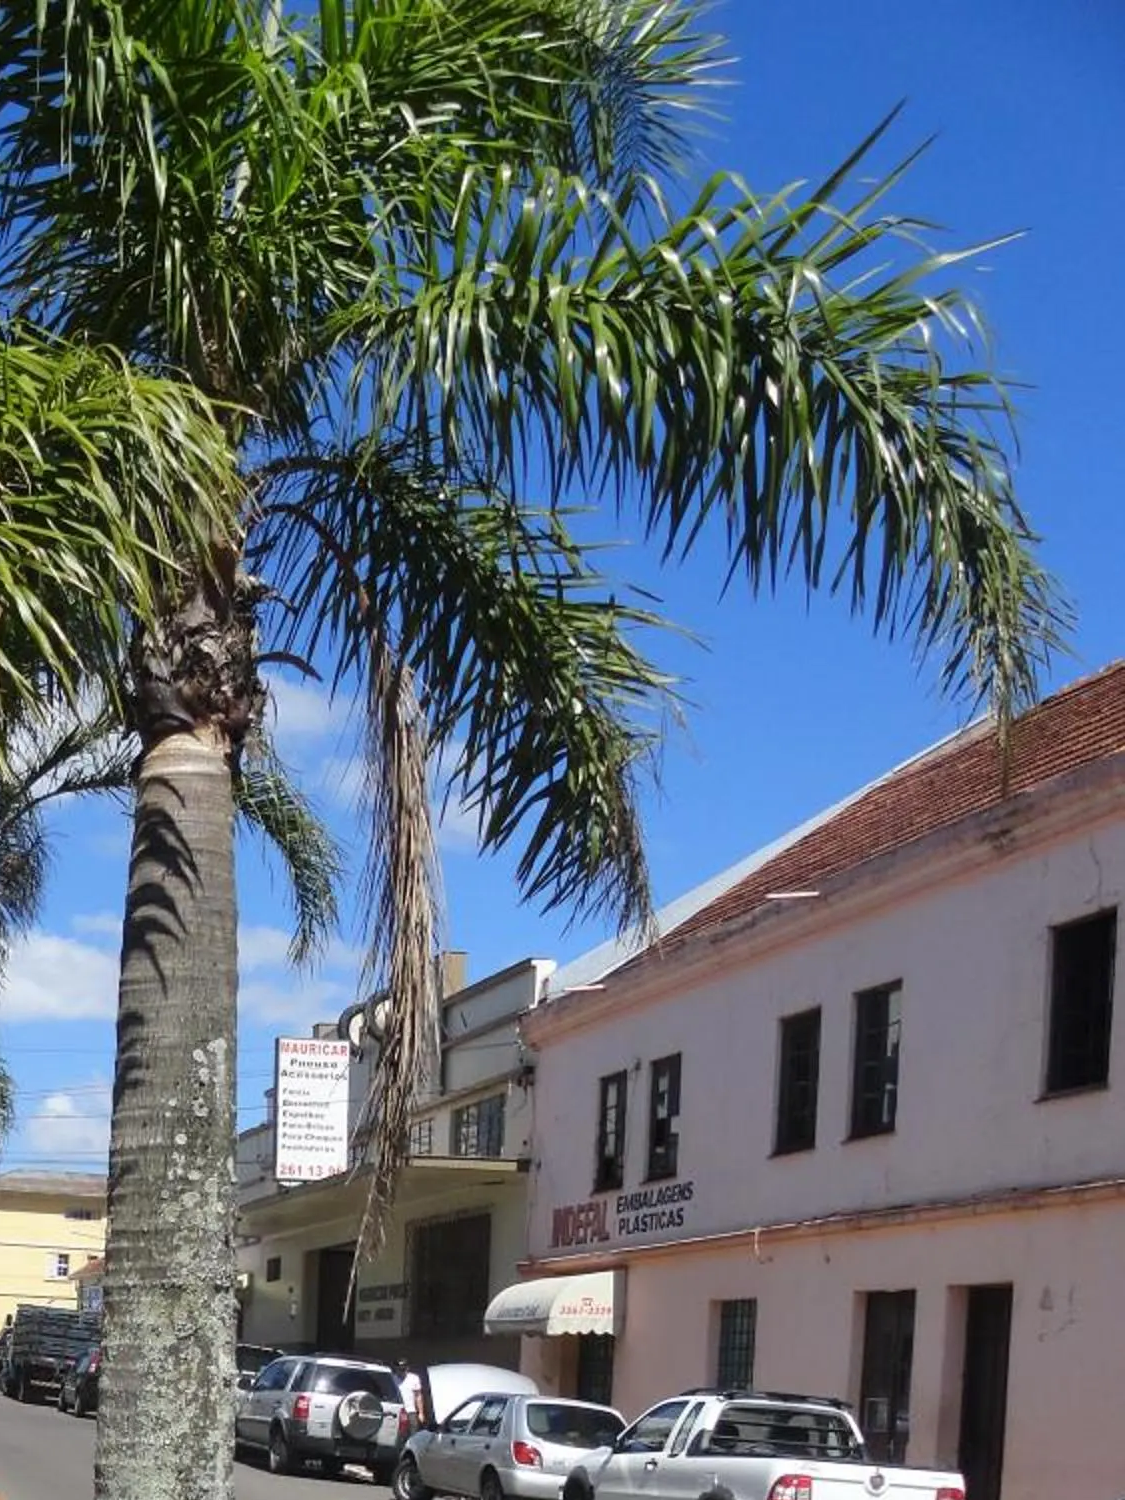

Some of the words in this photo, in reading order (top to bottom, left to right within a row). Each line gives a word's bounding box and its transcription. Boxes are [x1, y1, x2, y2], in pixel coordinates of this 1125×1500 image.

[281, 1041, 348, 1057] MAURICAR
[279, 1162, 302, 1177] 261
[307, 1165, 324, 1177] 13
[616, 1181, 694, 1214] EMBALAGENS
[618, 1207, 684, 1235] PLASTICAS
